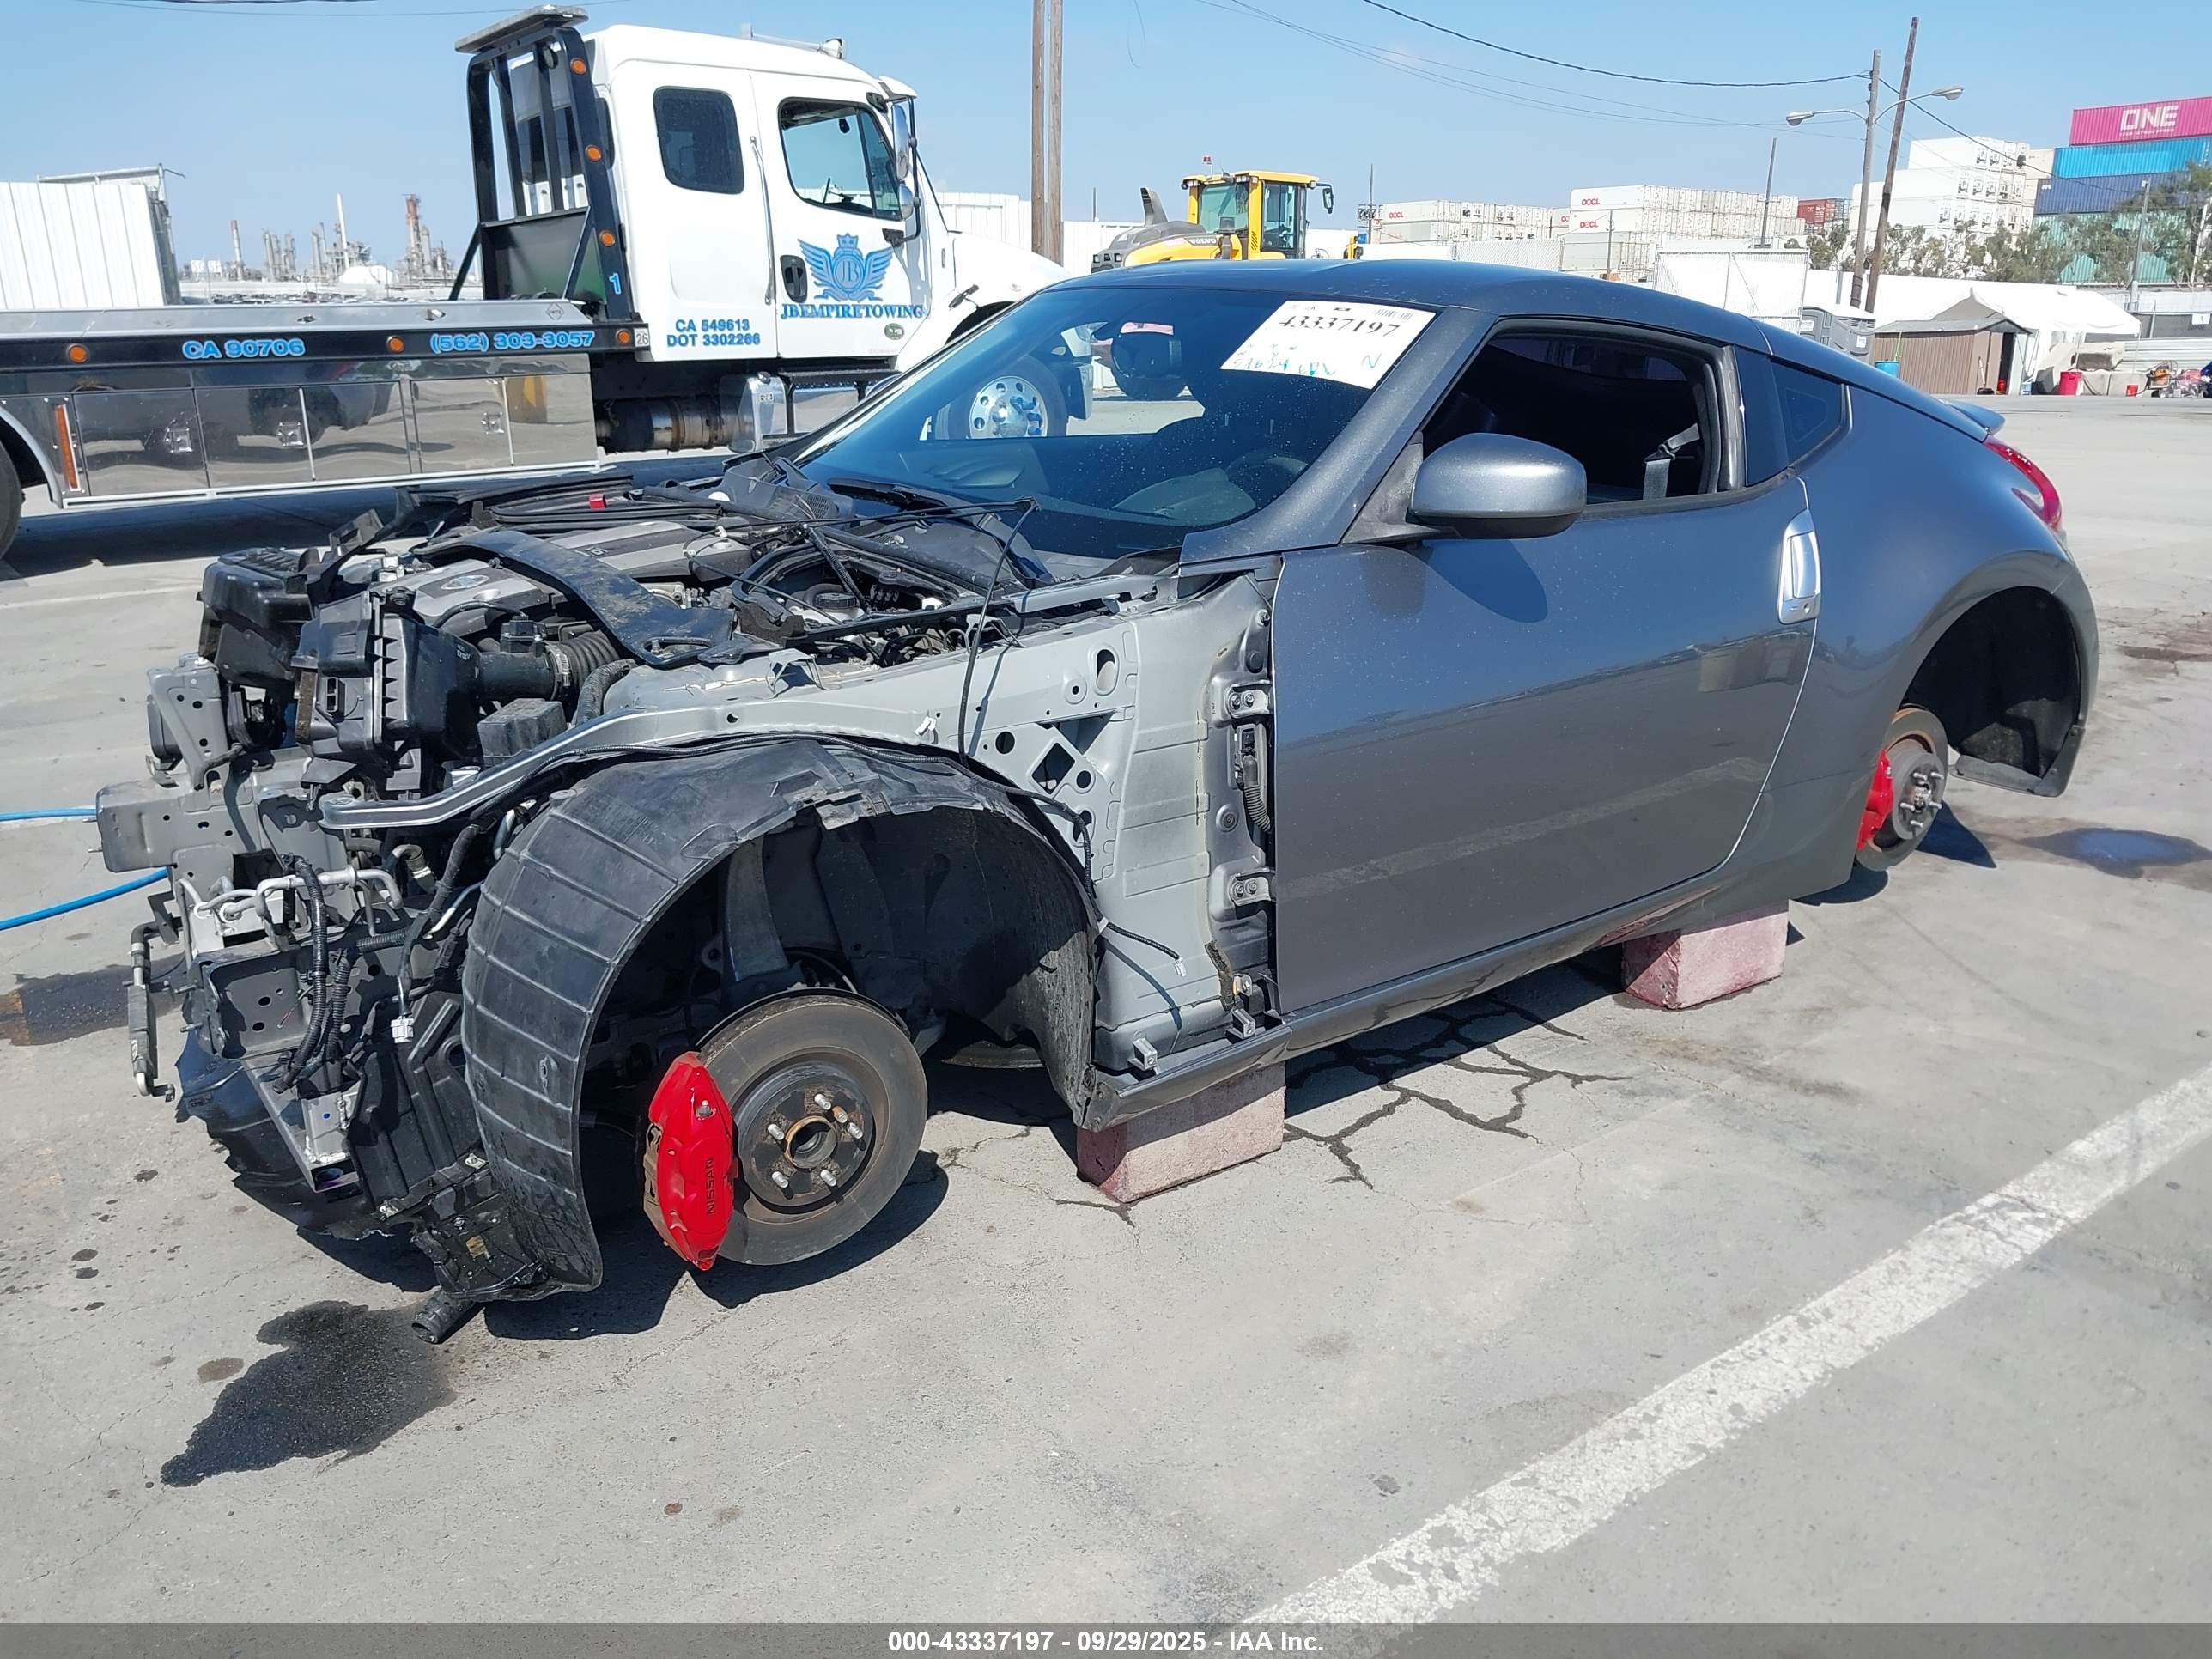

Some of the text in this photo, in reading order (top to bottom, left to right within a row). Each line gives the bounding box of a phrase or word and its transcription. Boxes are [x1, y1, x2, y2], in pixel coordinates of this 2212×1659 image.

[2120, 105, 2179, 131] ONE
[842, 260, 860, 283] JB
[609, 272, 622, 295] 1
[675, 319, 750, 332] CA 549613
[1279, 315, 1401, 337] 43337197
[182, 338, 305, 359] CA 90706
[430, 331, 595, 354] (562) 303-3057
[635, 333, 649, 345] 26
[666, 333, 761, 347] DOT 3302266
[705, 1158, 715, 1216] NISSAN
